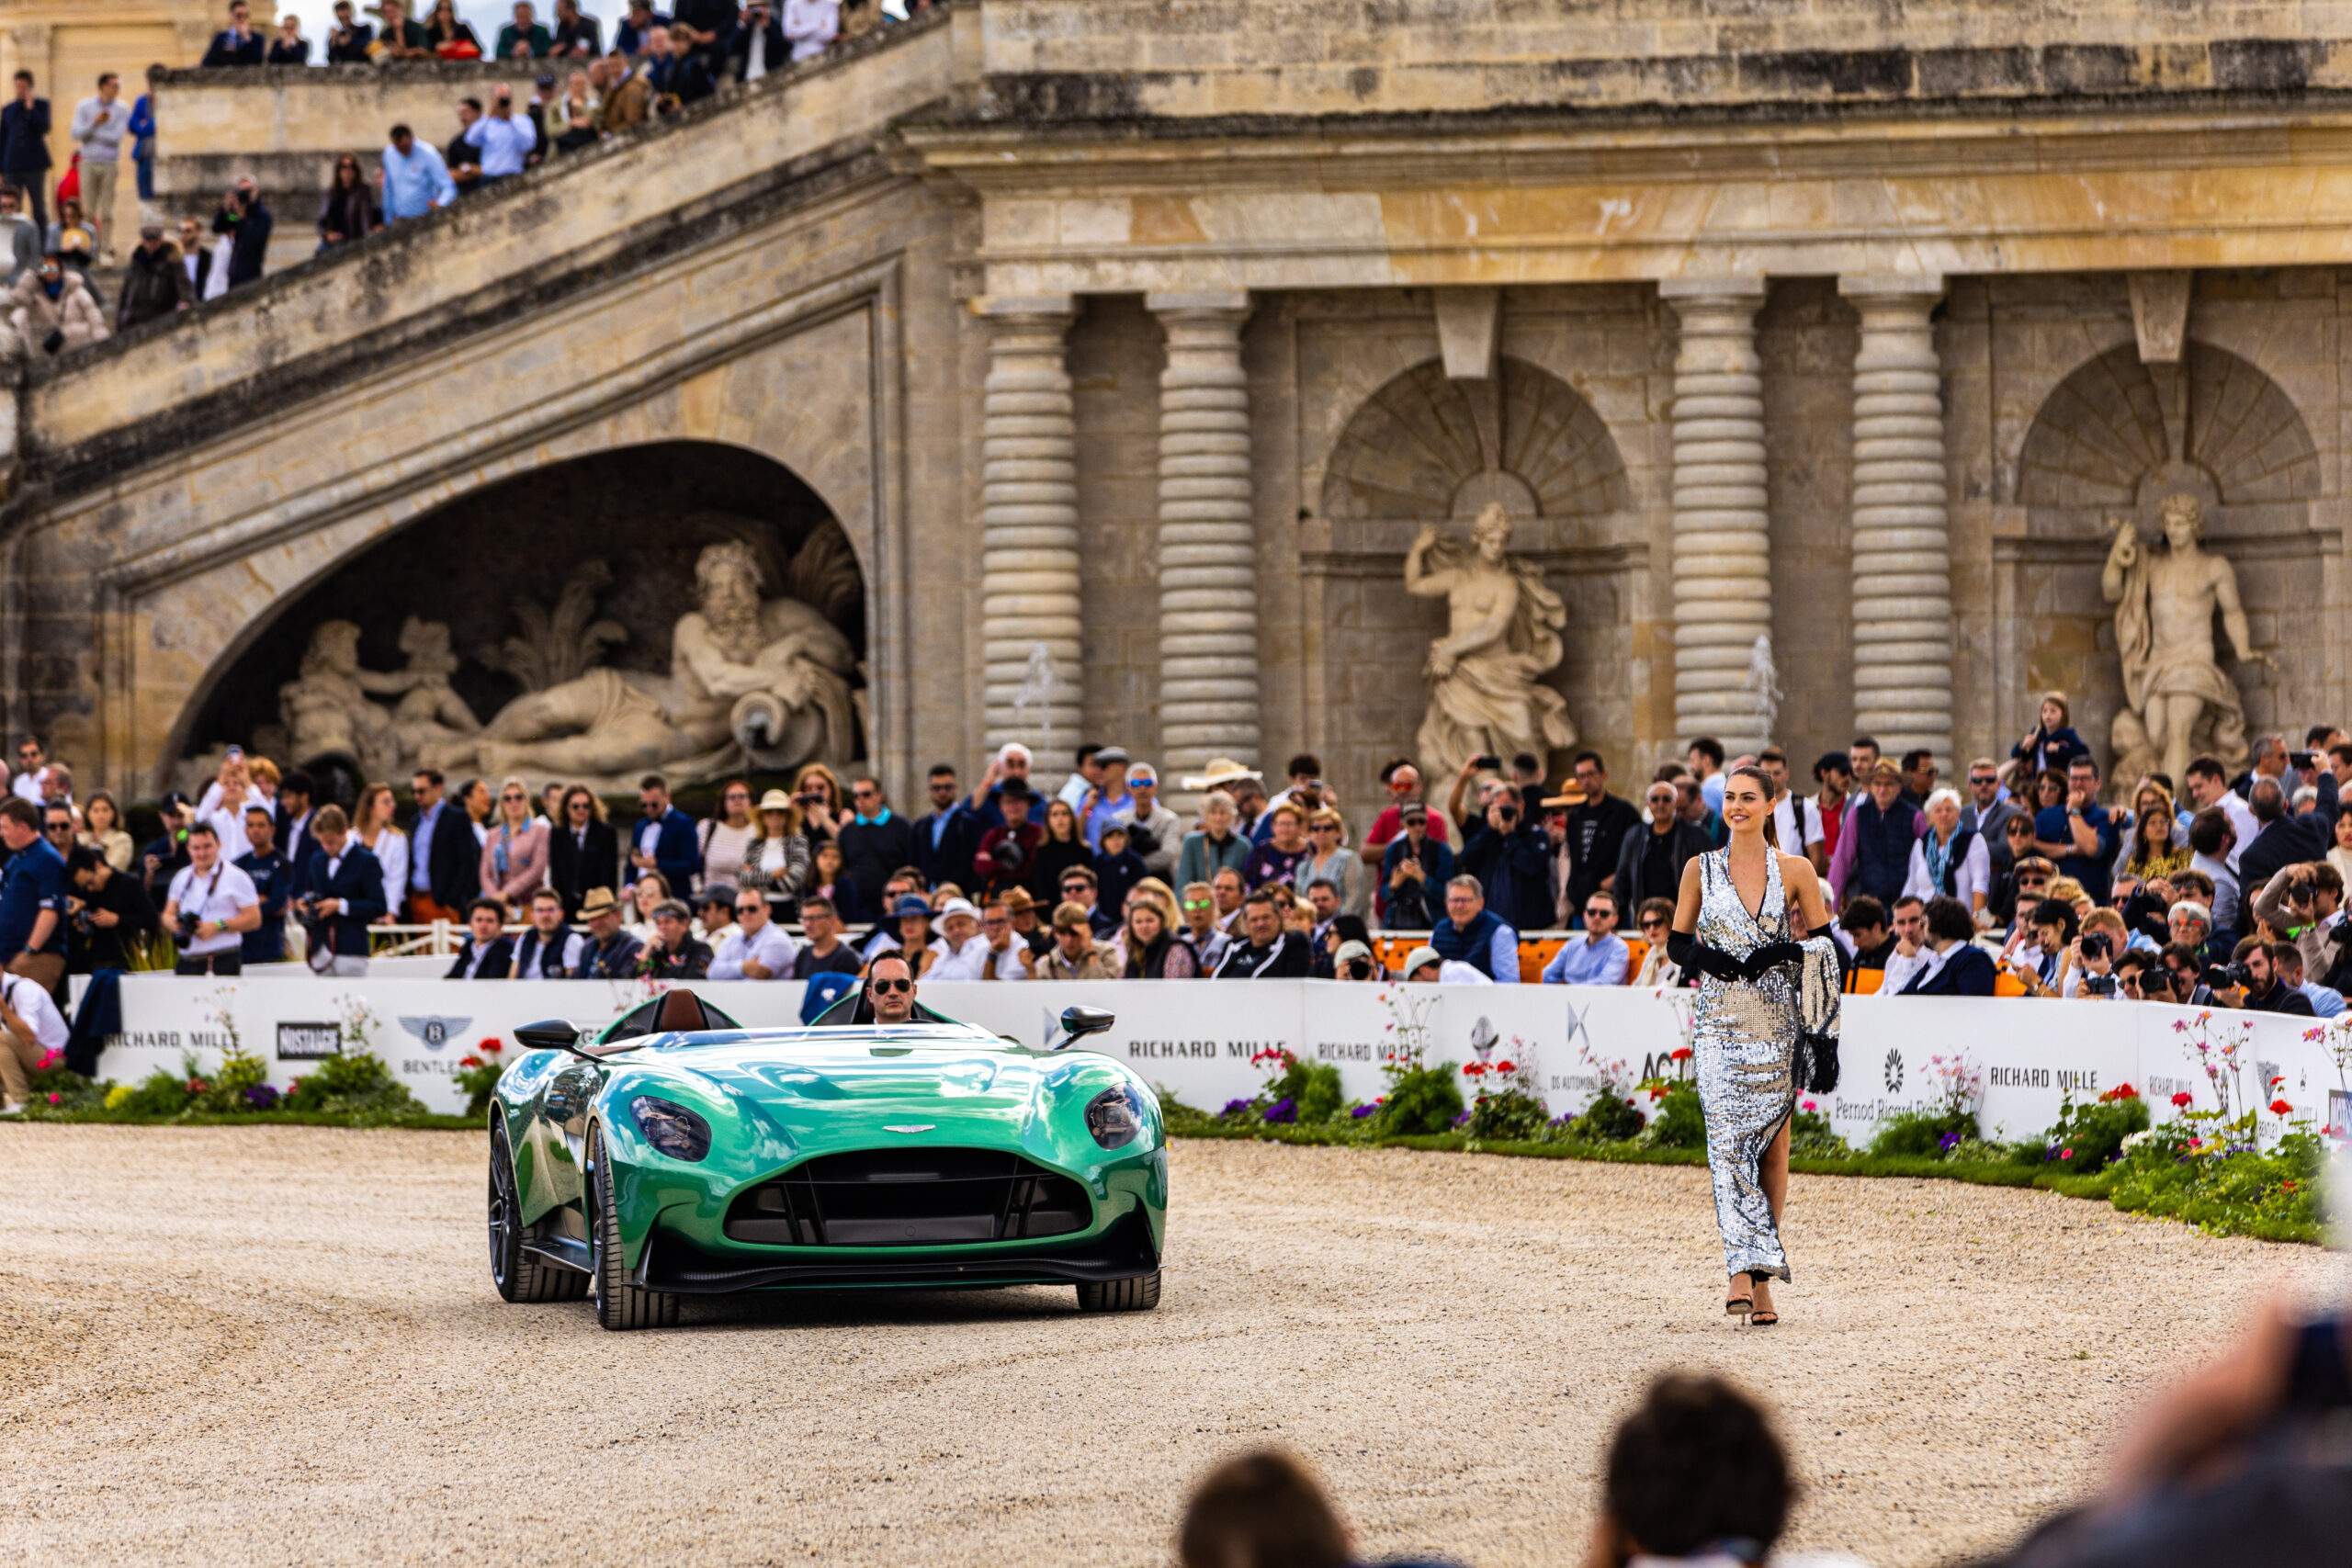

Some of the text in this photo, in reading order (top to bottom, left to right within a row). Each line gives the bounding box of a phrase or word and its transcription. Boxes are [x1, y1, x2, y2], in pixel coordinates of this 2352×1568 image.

[1129, 1041, 1216, 1058] RICHARD
[1318, 1043, 1371, 1061] RICHARD
[403, 1059, 459, 1074] BENTLE
[1990, 1066, 2098, 1090] RICHARD MILLE
[1836, 1097, 1874, 1120] Pernod
